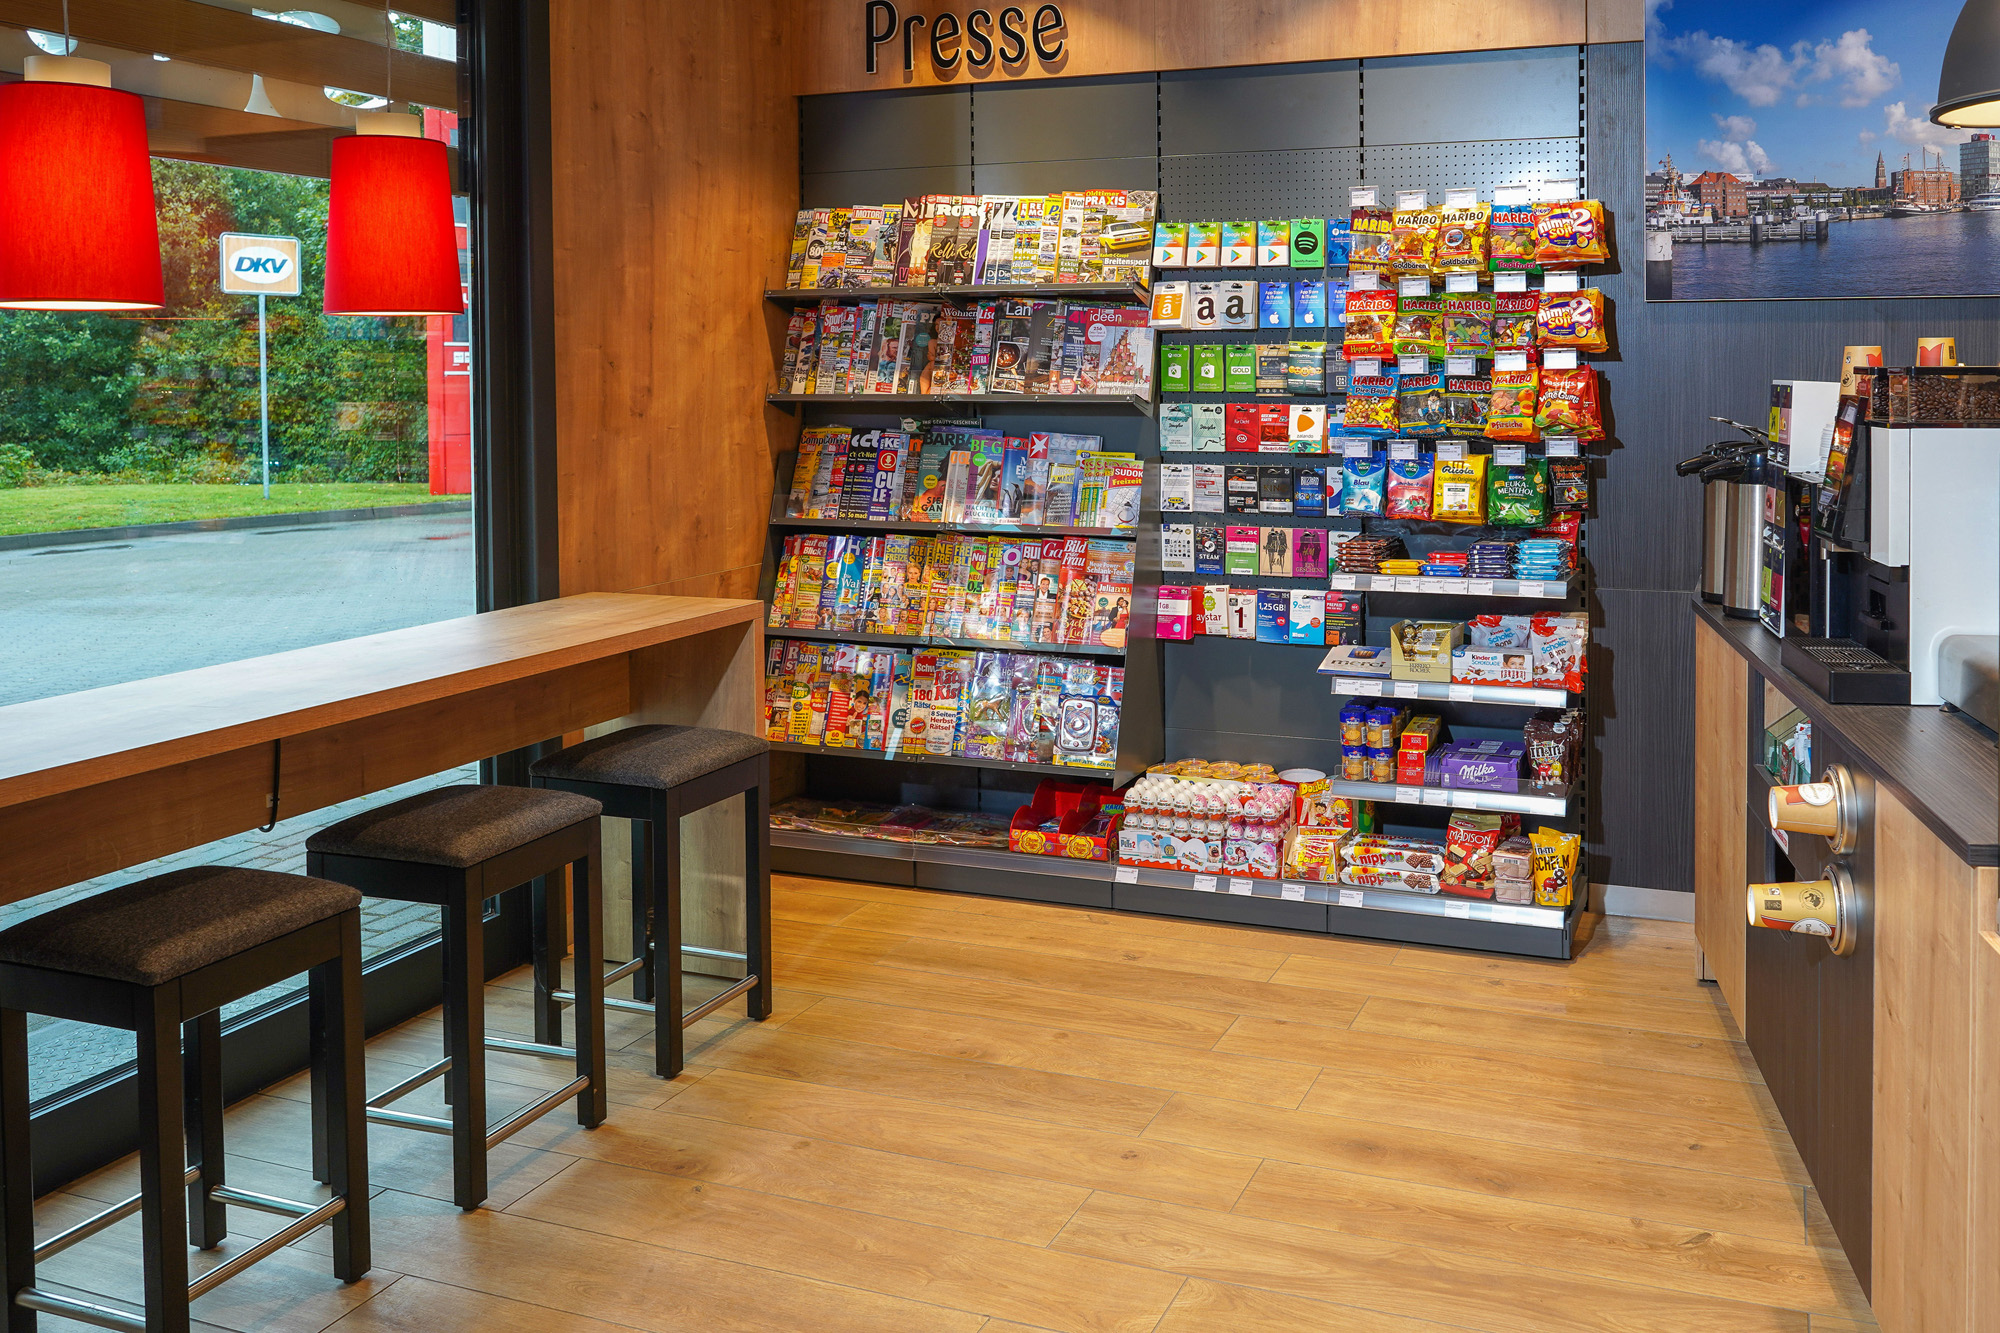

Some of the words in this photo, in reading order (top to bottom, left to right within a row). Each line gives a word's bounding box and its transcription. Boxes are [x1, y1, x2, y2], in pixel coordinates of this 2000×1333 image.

[866, 0, 1064, 74] Presse
[1086, 190, 1120, 198] Oldtimer
[1085, 197, 1126, 206] PRAXIS
[1397, 215, 1438, 225] HARIBO
[1442, 211, 1484, 223] HARIBO
[1494, 212, 1535, 224] HARIBO
[1538, 216, 1573, 233] nimm
[1569, 208, 1594, 233] 2
[1207, 231, 1216, 239] Play
[1240, 231, 1250, 239] Play
[1549, 223, 1573, 240] soft
[234, 256, 288, 274] DKV
[1104, 258, 1150, 267] Breitensport
[1393, 261, 1427, 270] Goldbären
[1441, 258, 1478, 266] Goldbären
[1496, 260, 1537, 270] Tropifrutti
[1162, 303, 1171, 315] a
[1197, 297, 1215, 320] a
[1225, 295, 1246, 319] a
[1349, 299, 1393, 311] HARIBO
[1448, 300, 1492, 311] HARIBO
[1496, 298, 1534, 311] HARIBO
[1538, 305, 1573, 323] nimm
[1569, 296, 1593, 323] 2
[943, 307, 977, 320] Wohnen
[1090, 308, 1122, 322] ideen
[1548, 312, 1572, 330] soft
[972, 355, 987, 364] EXTRA
[1352, 376, 1394, 386] HARIBO
[1401, 374, 1439, 389] HARIBO
[1449, 380, 1492, 391] HARIBO
[1494, 373, 1533, 386] HARIBO
[1491, 420, 1523, 430] Pfirsiche
[1050, 437, 1096, 451] stern
[1441, 465, 1475, 475] Ricola
[1553, 464, 1586, 472] Türkisch
[1112, 478, 1142, 486] Freizeit
[1556, 472, 1582, 480] Pfeffer
[1497, 486, 1534, 496] MENTHOL
[804, 547, 822, 555] Blick
[1064, 539, 1087, 554] Bild
[1061, 552, 1086, 567] Frau
[1098, 584, 1115, 592] Julia
[1292, 600, 1298, 608] 9
[1196, 613, 1222, 623] aystar
[1234, 607, 1243, 628] 1
[1487, 633, 1515, 644] Schoko-
[1495, 639, 1513, 647] Bons
[1541, 640, 1569, 655] Schoko-
[1549, 648, 1567, 659] Bons
[1471, 653, 1490, 661] kinder
[1331, 658, 1386, 669] merci
[913, 689, 933, 701] 180
[929, 723, 951, 731] Rätsel
[1459, 762, 1496, 780] Milka
[1301, 781, 1330, 794] Double
[1449, 830, 1491, 844] MADISON
[1358, 851, 1403, 866] nippon
[1535, 854, 1570, 872] SCHELM
[1356, 871, 1401, 885] nippon
[1553, 867, 1568, 888] &
